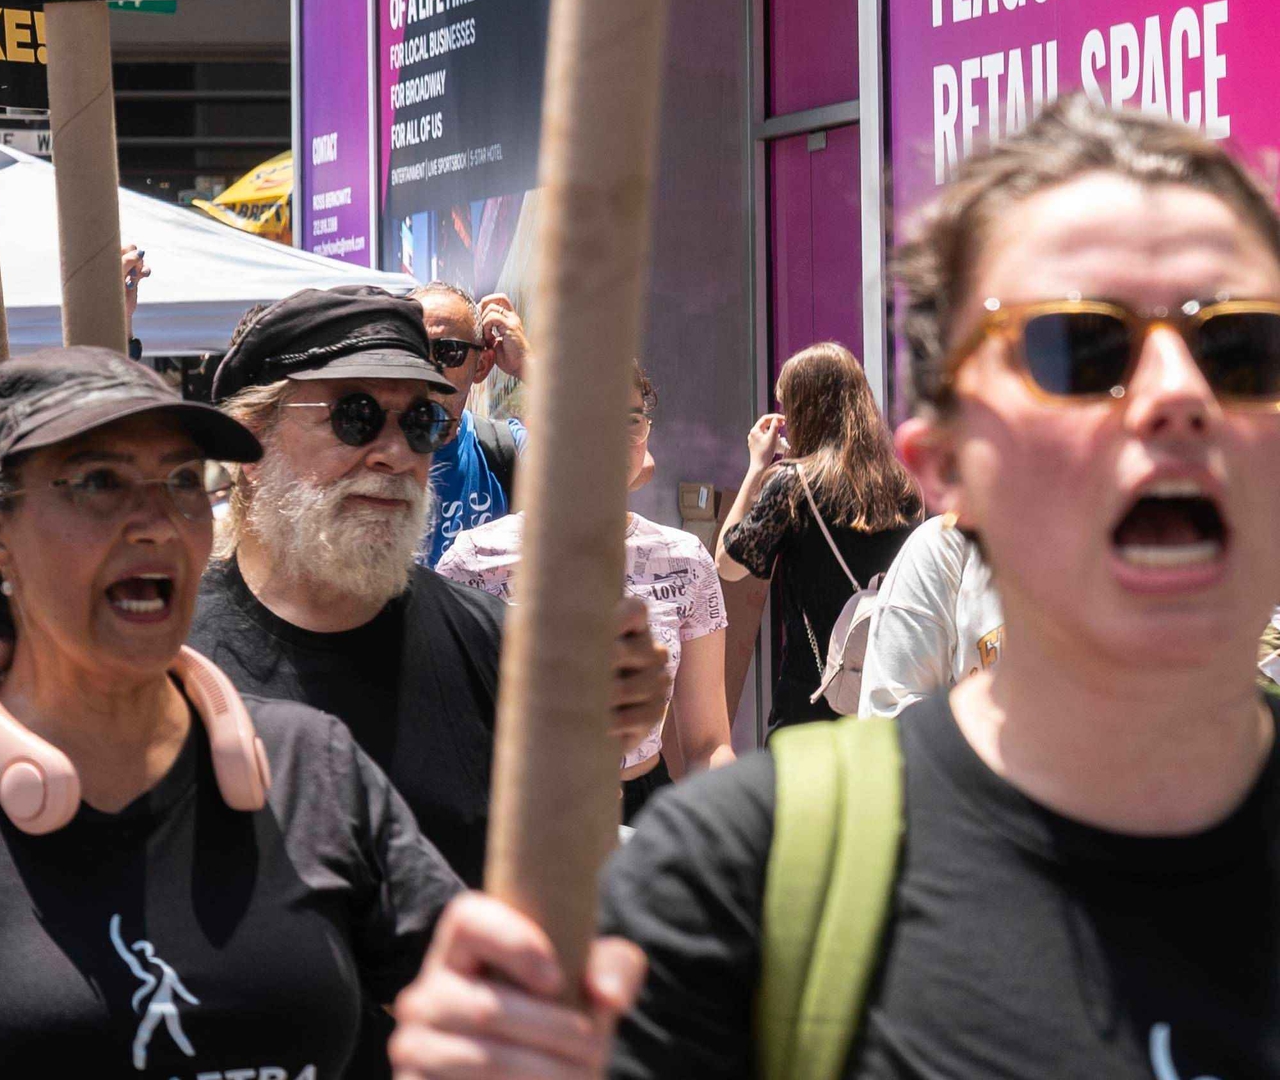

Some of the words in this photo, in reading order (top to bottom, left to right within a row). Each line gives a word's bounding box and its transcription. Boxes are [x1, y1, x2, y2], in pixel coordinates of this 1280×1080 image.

[390, 41, 405, 70] FOR
[405, 32, 429, 65] LOCAL
[429, 17, 476, 60] BUSINESSES
[391, 83, 405, 111] FOR
[405, 69, 447, 106] BROADWAY
[1080, 0, 1231, 140] SPACE
[391, 122, 406, 150] FOR
[406, 117, 420, 147] ALL
[420, 114, 431, 142] OF
[431, 111, 443, 139] US
